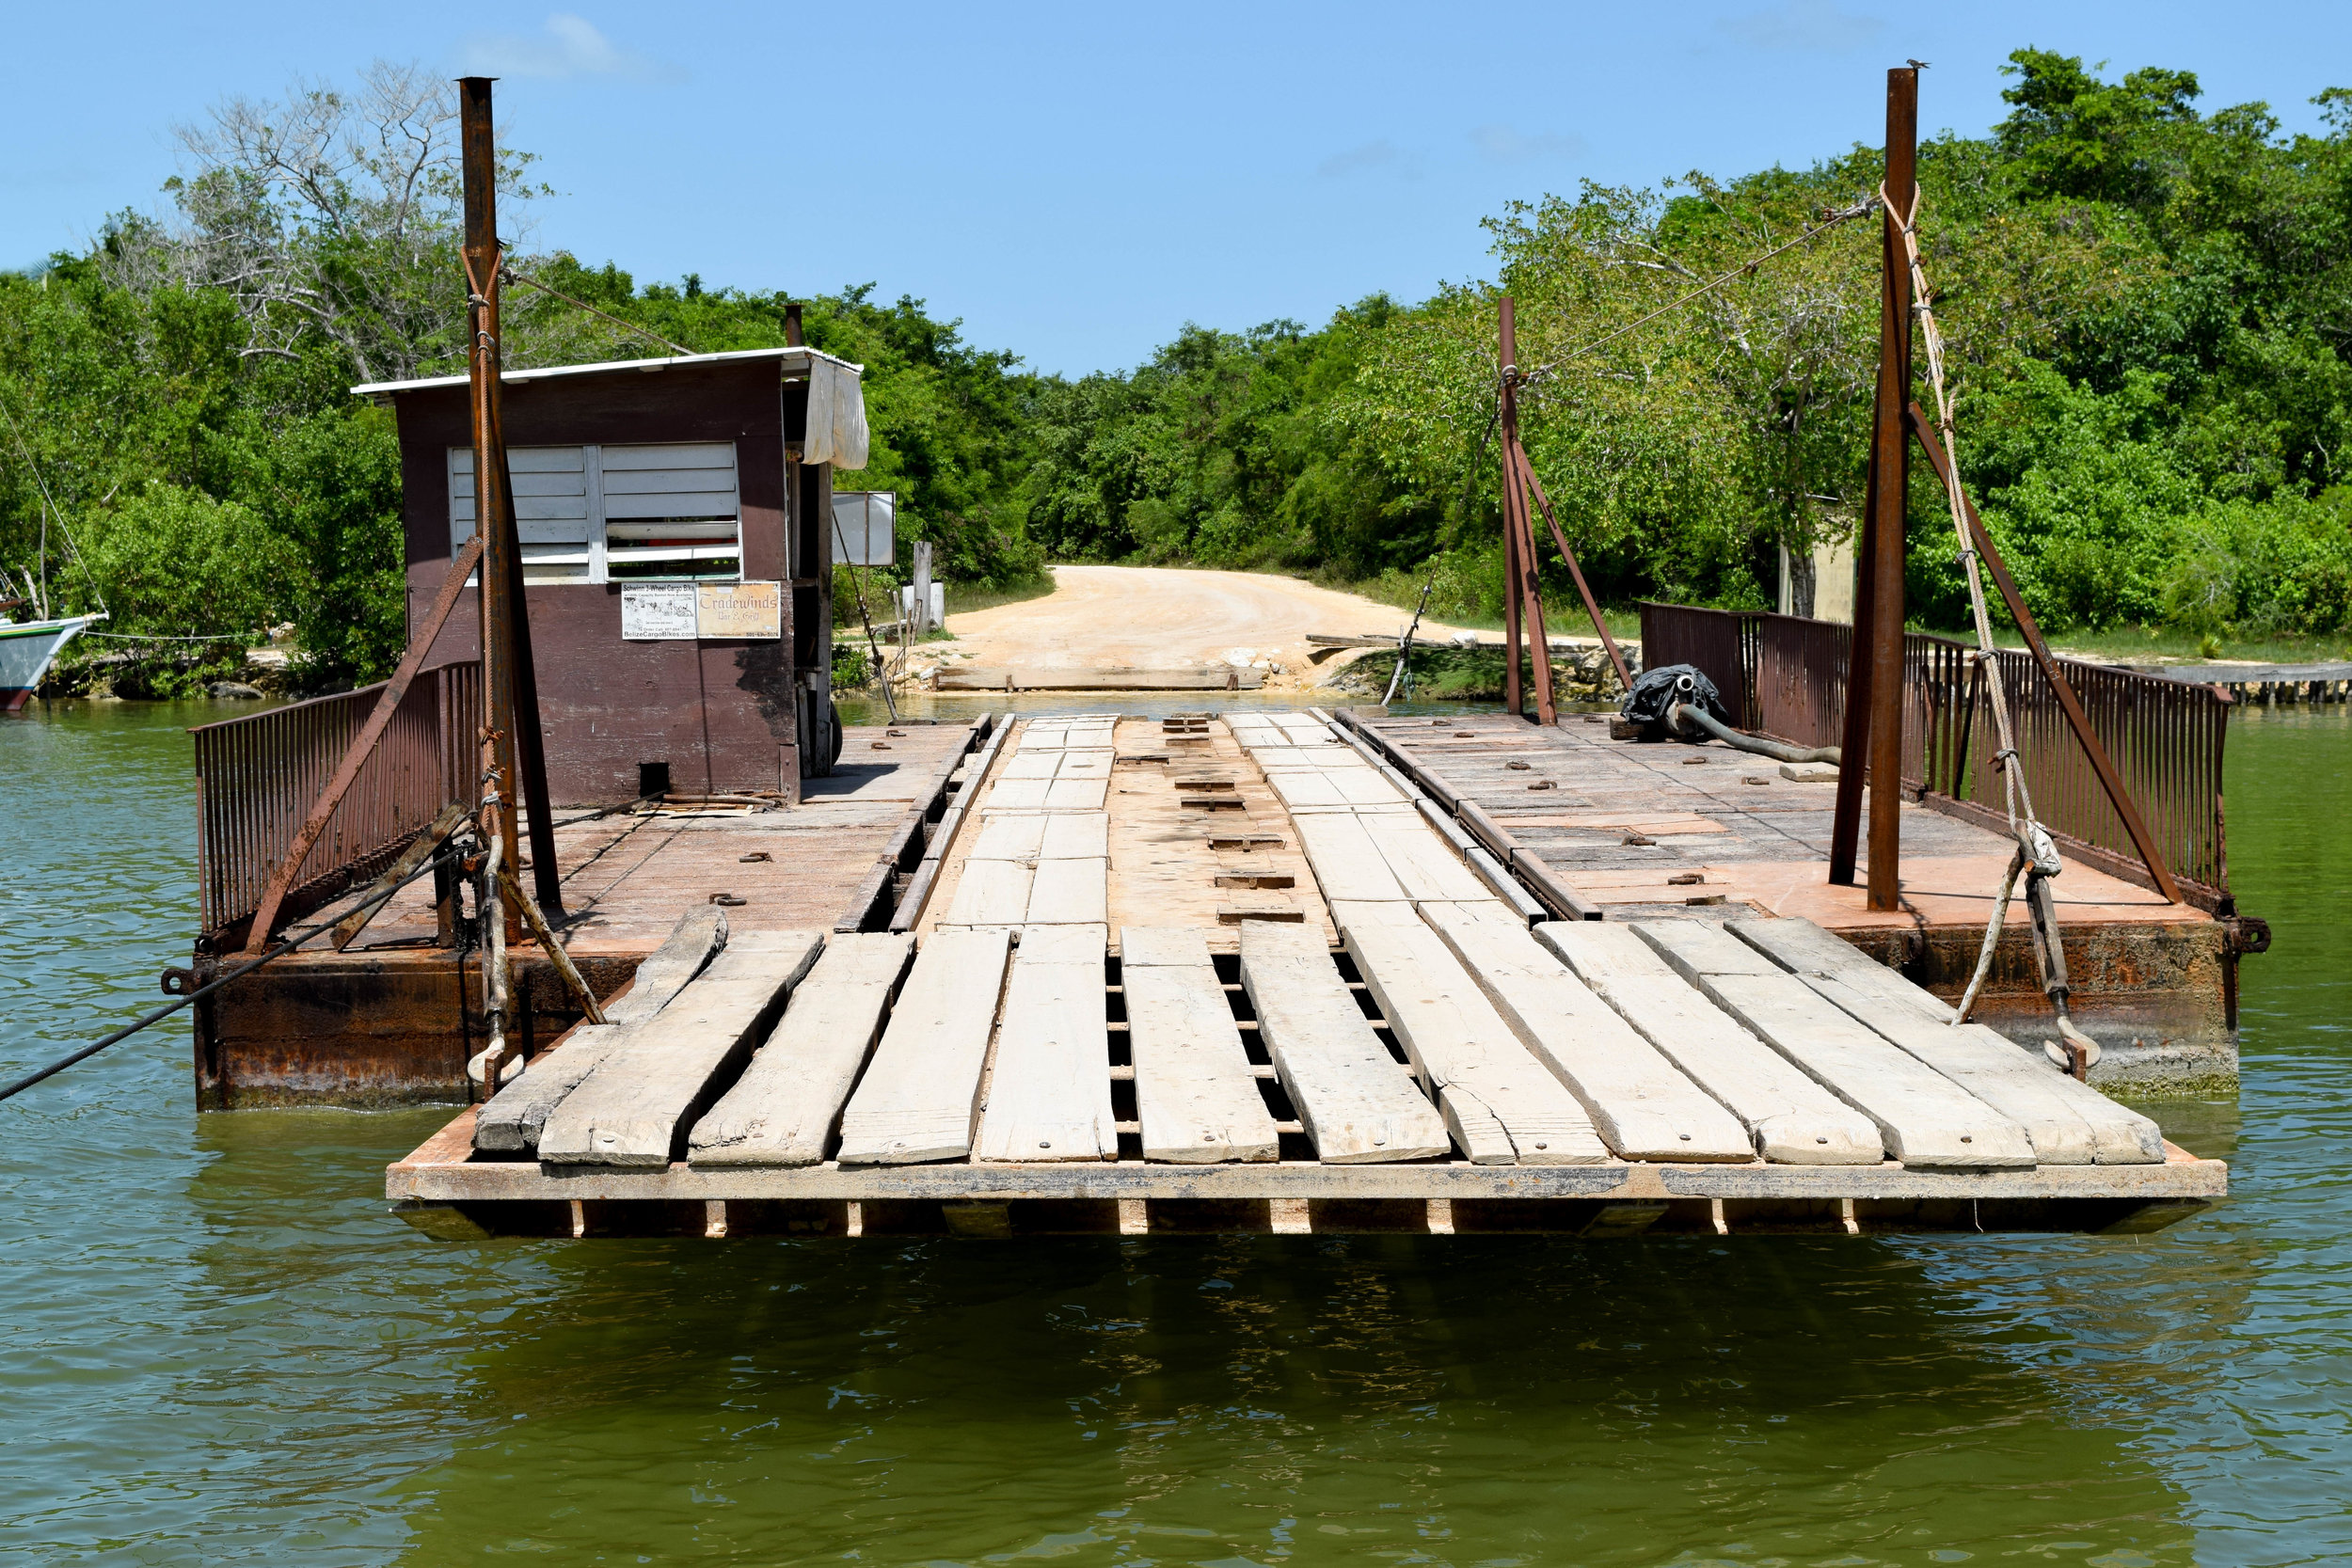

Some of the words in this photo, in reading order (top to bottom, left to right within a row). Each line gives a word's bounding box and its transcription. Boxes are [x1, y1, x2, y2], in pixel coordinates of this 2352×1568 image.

[667, 584, 683, 594] Cargo
[700, 592, 778, 610] Tradewinds
[718, 611, 730, 621] Bar
[732, 611, 739, 622] &
[741, 611, 759, 623] Grill
